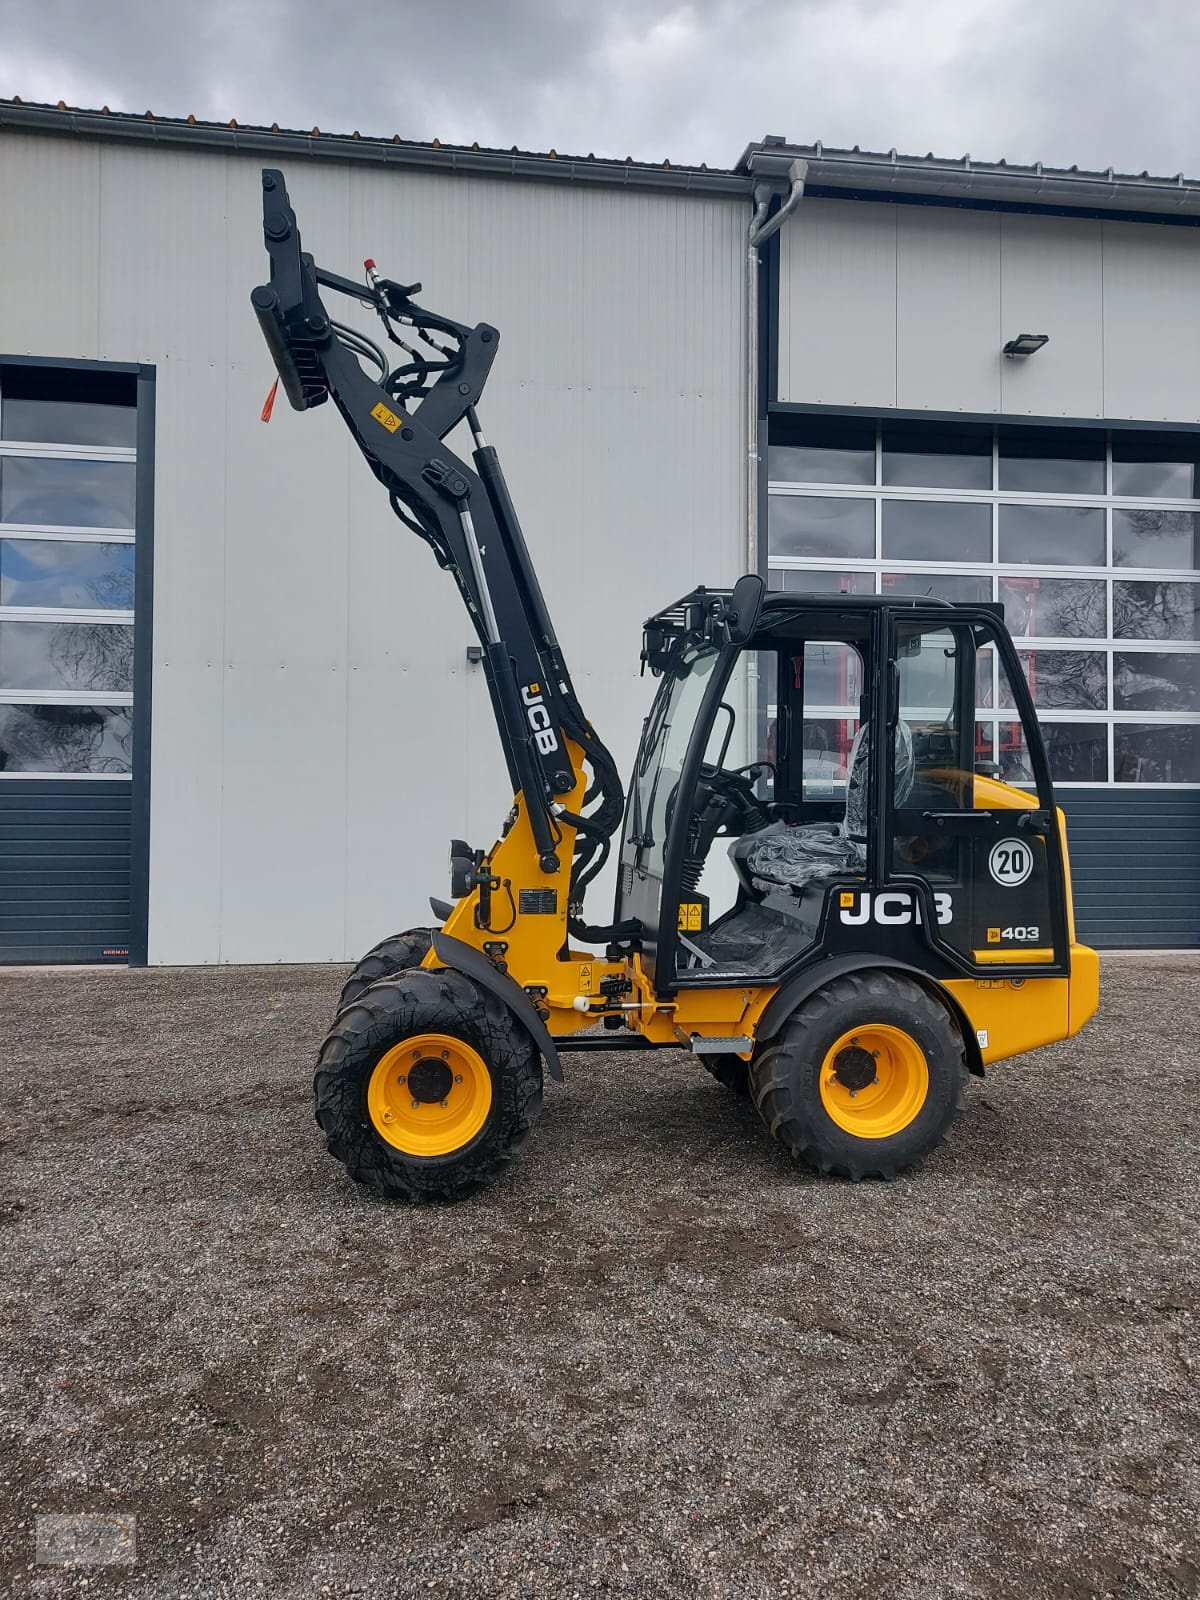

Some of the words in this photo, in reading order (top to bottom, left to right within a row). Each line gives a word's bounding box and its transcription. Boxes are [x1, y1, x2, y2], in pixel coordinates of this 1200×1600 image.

[521, 685, 558, 755] JCB
[998, 850, 1023, 874] 20
[840, 893, 952, 925] JCB
[1001, 927, 1039, 939] 403
